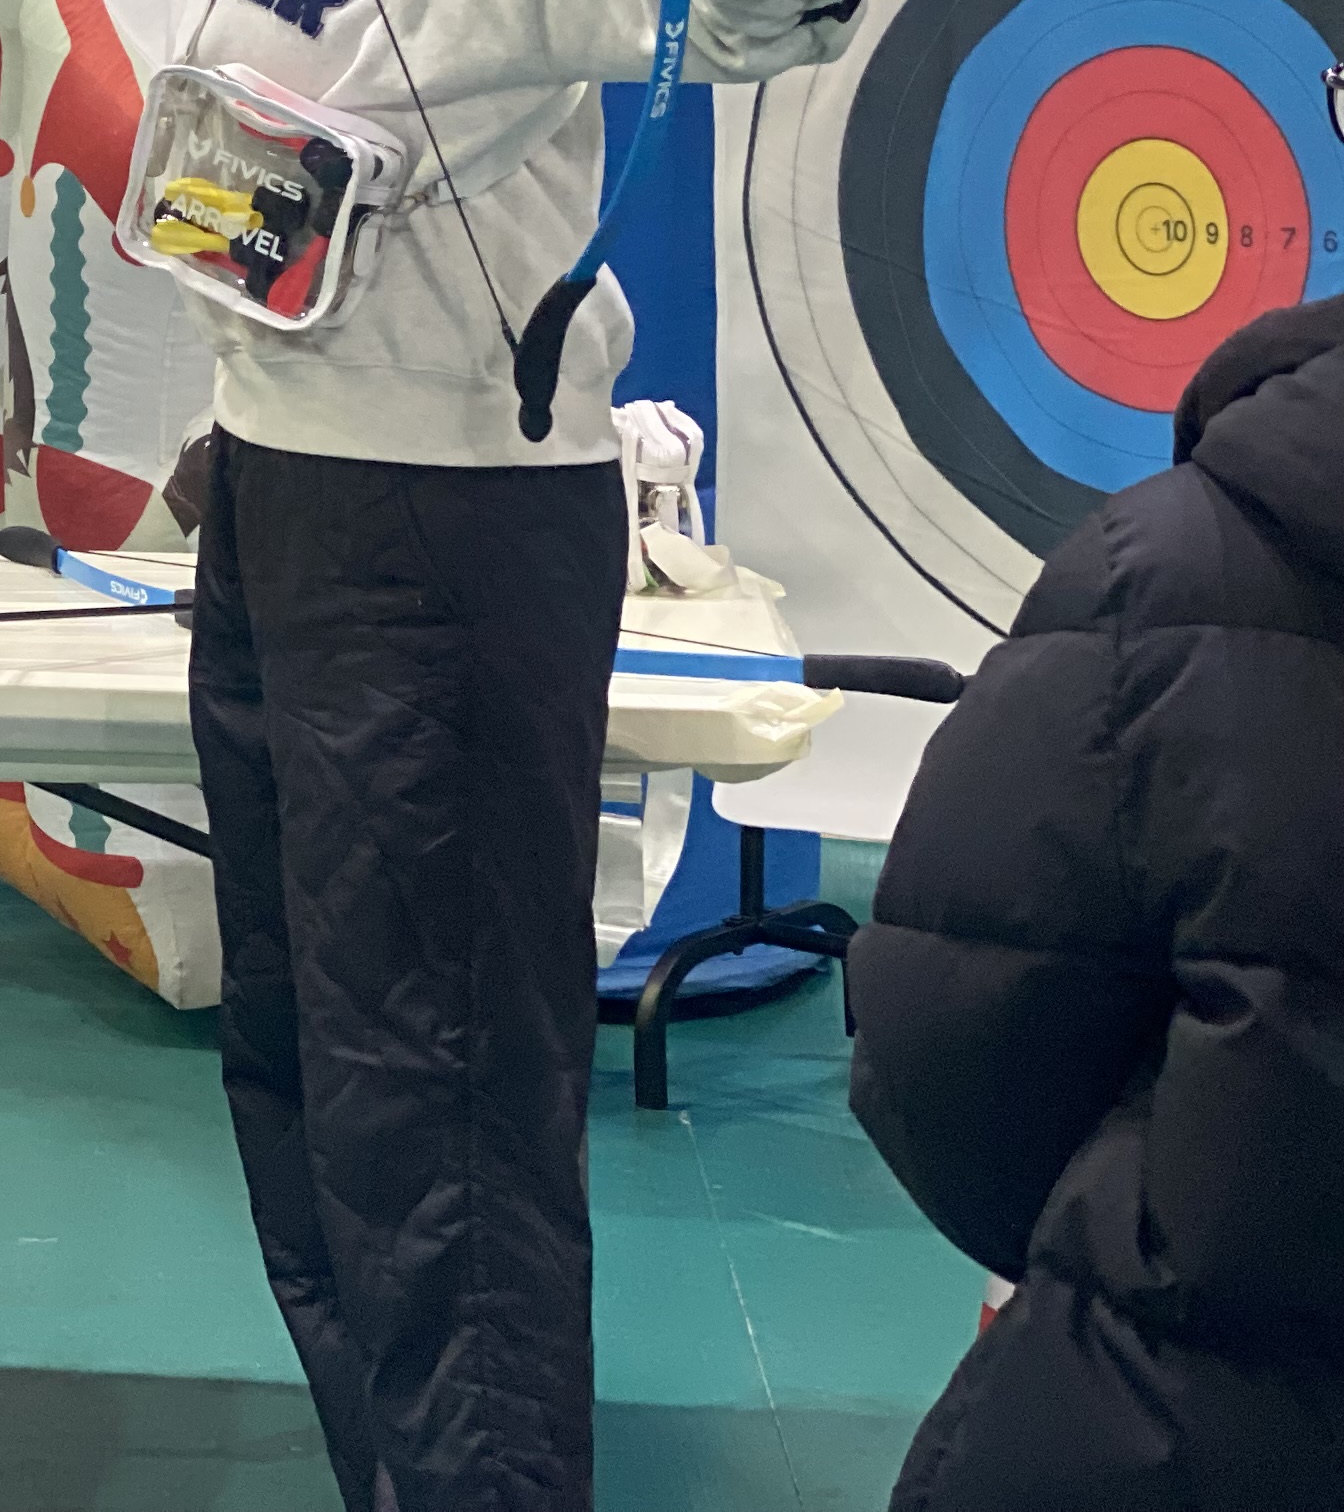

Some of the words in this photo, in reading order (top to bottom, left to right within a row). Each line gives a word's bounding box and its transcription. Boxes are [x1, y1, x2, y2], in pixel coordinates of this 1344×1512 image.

[650, 40, 679, 119] FIVICS
[213, 149, 305, 203] FIVICS
[1162, 219, 1187, 243] 10
[1205, 221, 1220, 245] 9
[1240, 224, 1254, 248] 8
[1280, 227, 1297, 250] 7
[1322, 230, 1339, 253] 6
